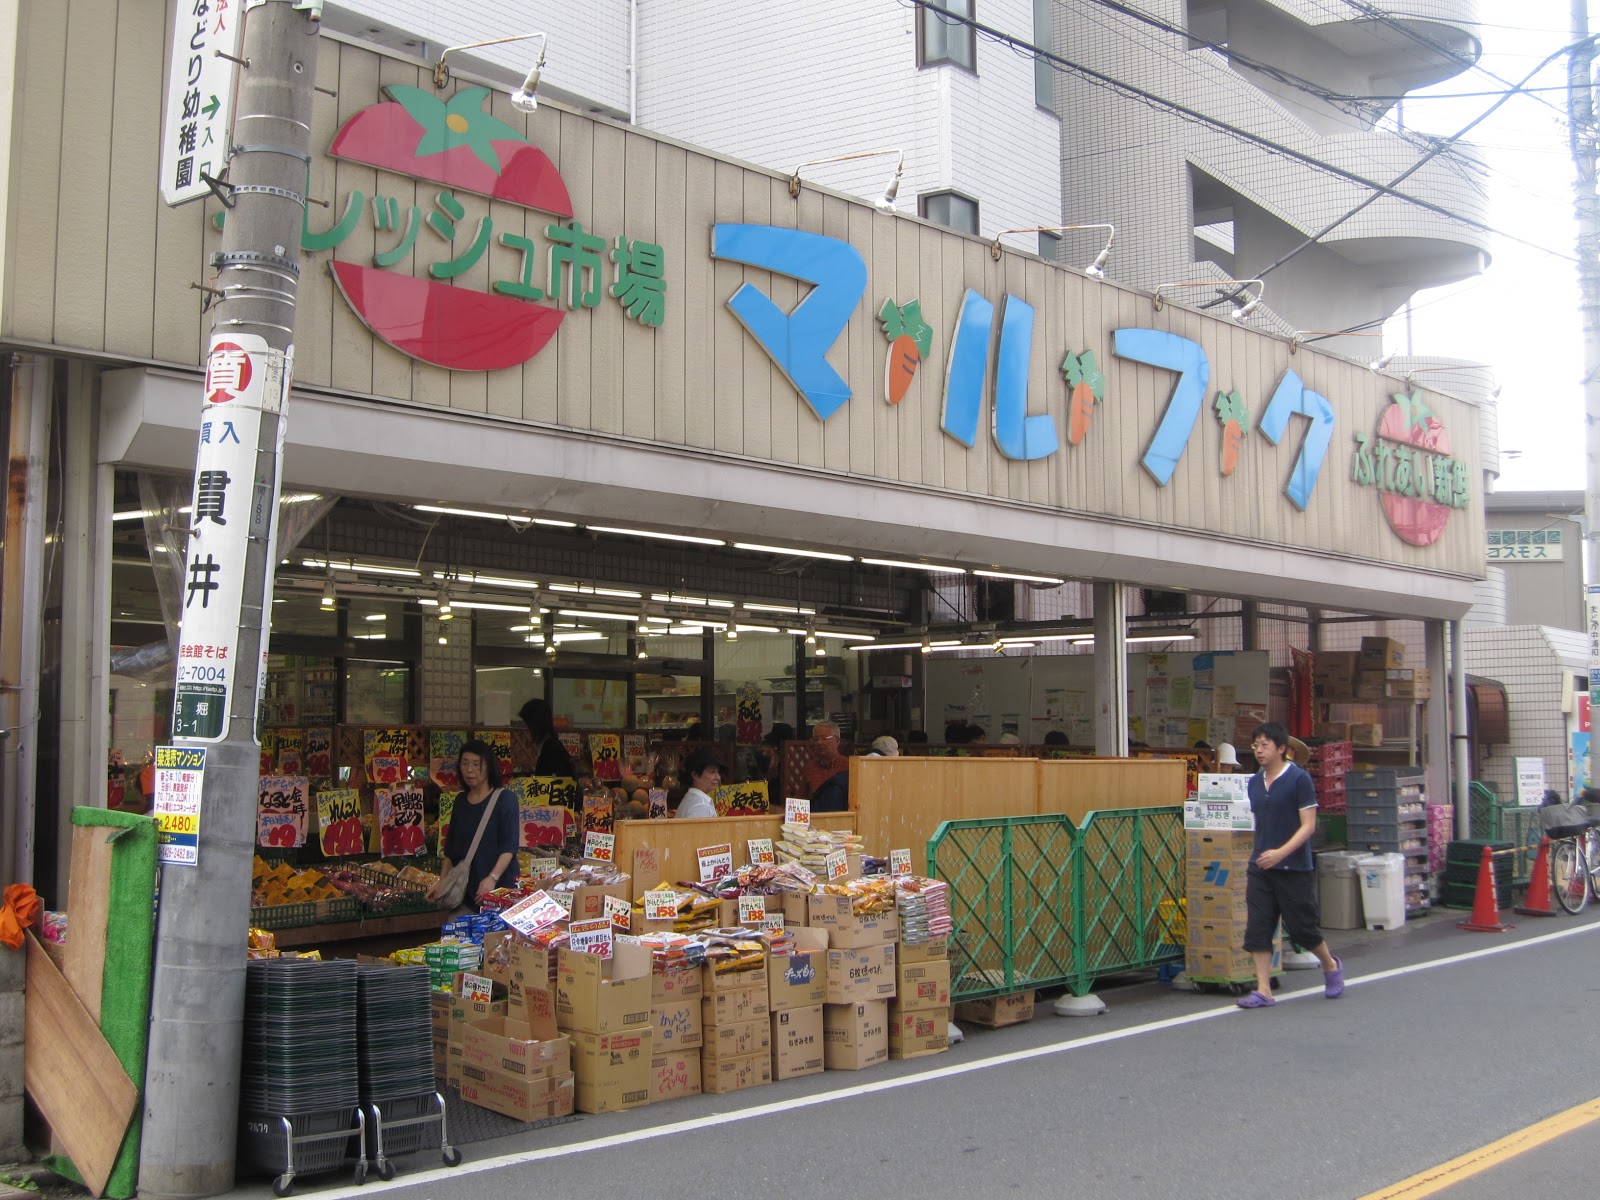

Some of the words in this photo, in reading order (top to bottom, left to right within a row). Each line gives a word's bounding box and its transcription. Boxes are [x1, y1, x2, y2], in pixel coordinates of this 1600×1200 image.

[213, 188, 667, 328] レッシュ市場
[186, 469, 232, 609] 貫井
[1487, 546, 1547, 559] コスモス
[793, 812, 809, 823] 138
[593, 847, 611, 860] 98
[758, 852, 774, 863] 138
[712, 864, 730, 879] 158
[833, 863, 848, 877] 138
[898, 863, 911, 874] 105
[657, 905, 676, 917] 158
[747, 910, 764, 921] 138
[611, 913, 630, 927] 98
[784, 964, 816, 982] チーズもち
